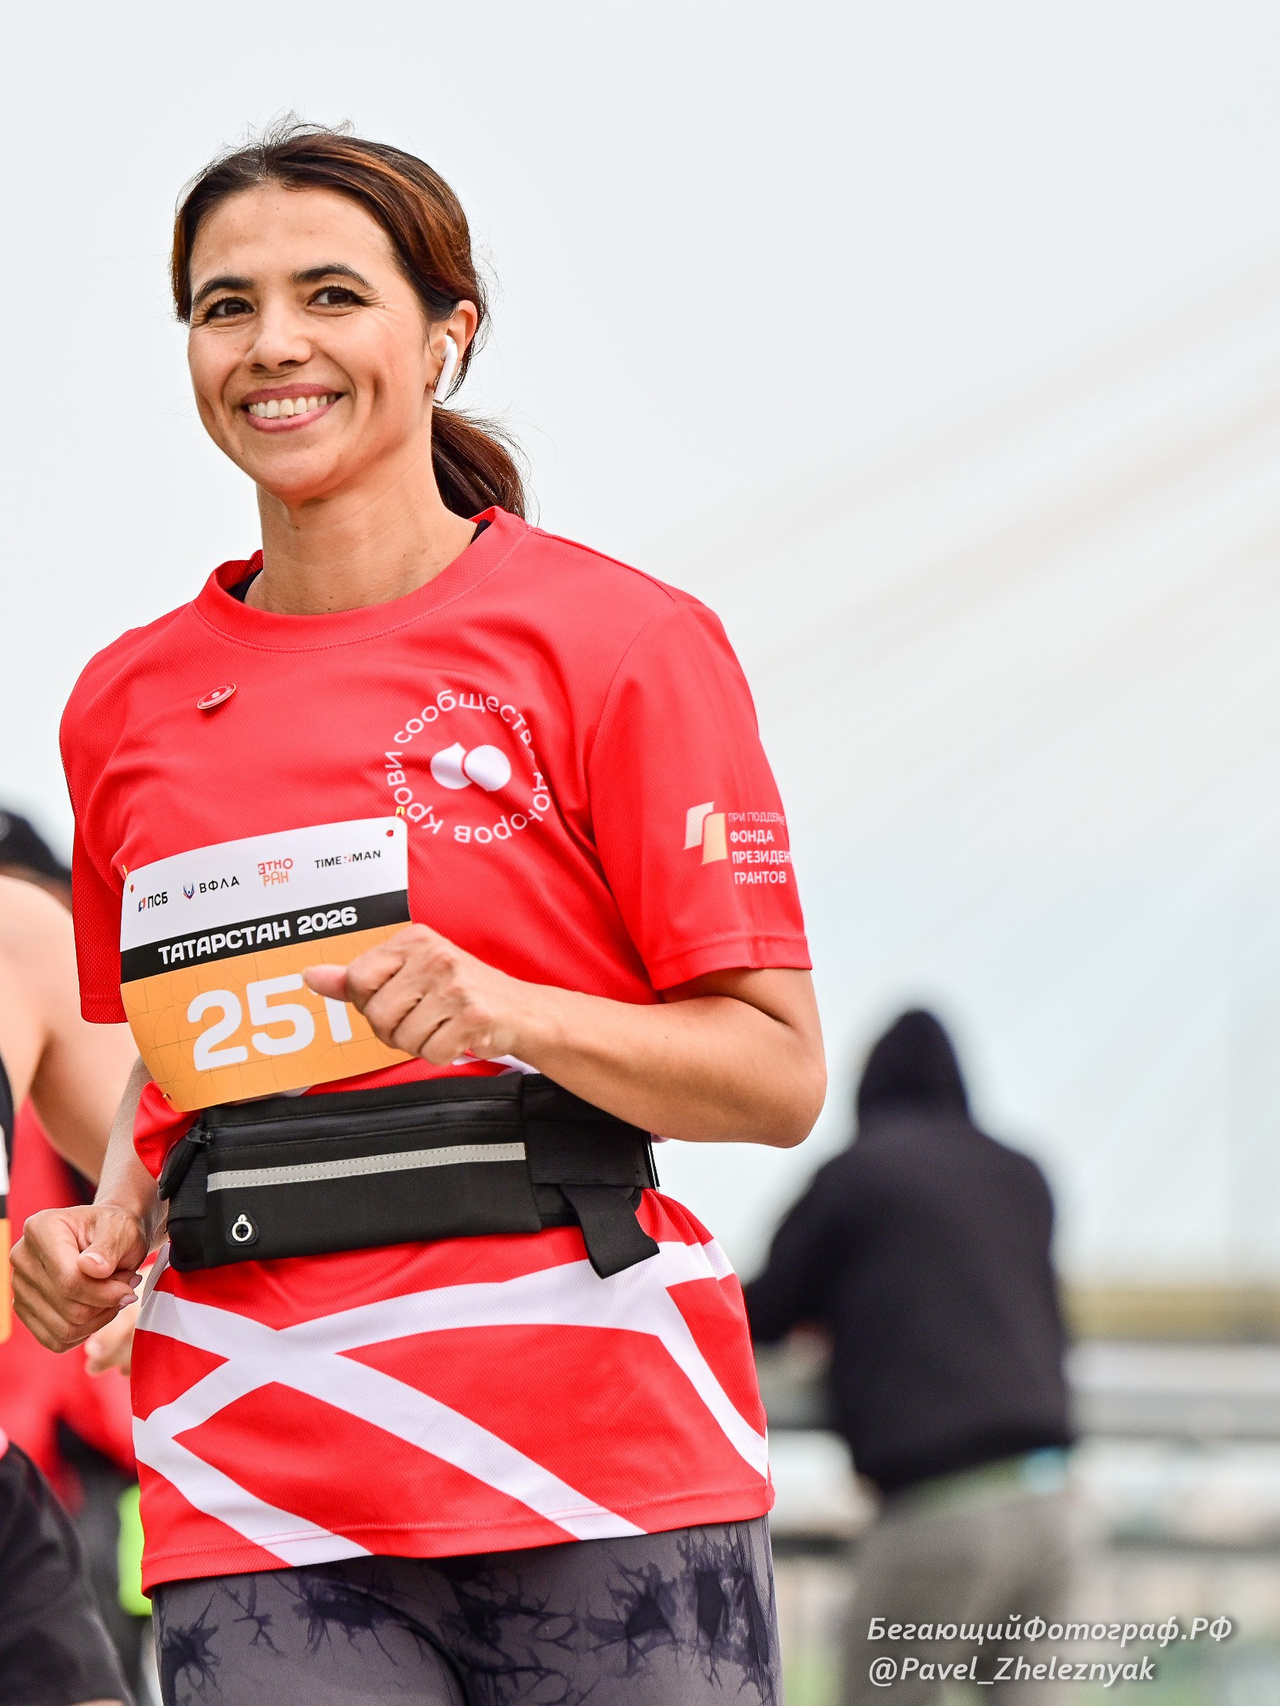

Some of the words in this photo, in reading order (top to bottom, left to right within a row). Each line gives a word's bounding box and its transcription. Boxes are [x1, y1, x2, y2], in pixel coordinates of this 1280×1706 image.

[385, 751, 444, 834] крови
[728, 812, 746, 822] ПРИ
[730, 830, 774, 844] ФОНДА
[732, 850, 791, 865] ПРЕЗИДЕН
[199, 876, 240, 894] ВФЛА
[734, 871, 787, 884] ГРАНТОВ
[147, 891, 169, 909] ПСБ
[158, 919, 291, 965] ТАТАРСТАН
[297, 906, 358, 935] 2026
[187, 973, 352, 1072] 251
